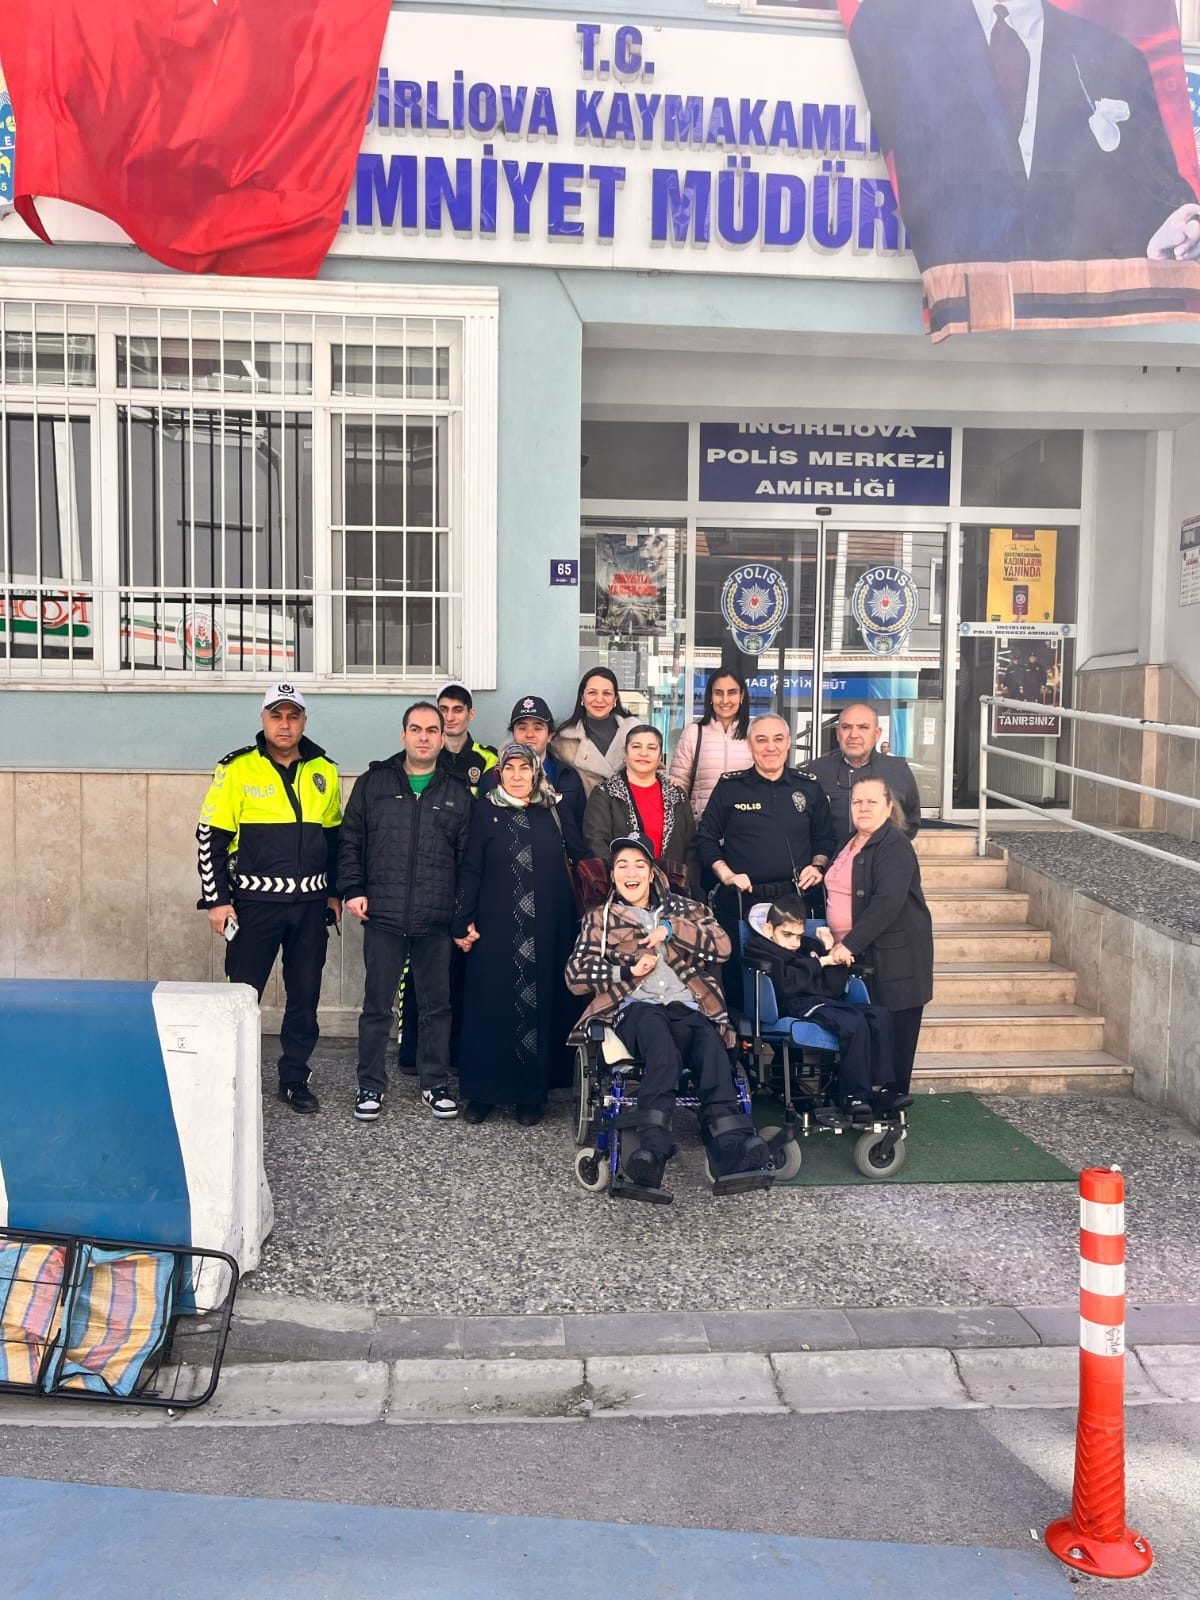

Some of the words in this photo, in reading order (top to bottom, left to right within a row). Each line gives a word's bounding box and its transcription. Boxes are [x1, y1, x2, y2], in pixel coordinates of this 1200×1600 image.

[576, 23, 655, 76] T.C.
[366, 67, 558, 137] İRLİOVA
[341, 144, 626, 240] MNİYET
[651, 155, 912, 251] MÜDÜR
[707, 446, 799, 465] POLİS
[808, 450, 945, 469] MERKEZİ
[755, 477, 895, 497] AMİRLİĞİ
[557, 563, 572, 576] 65
[1003, 557, 1042, 567] KADINLARIN
[1003, 566, 1041, 577] YANINDA
